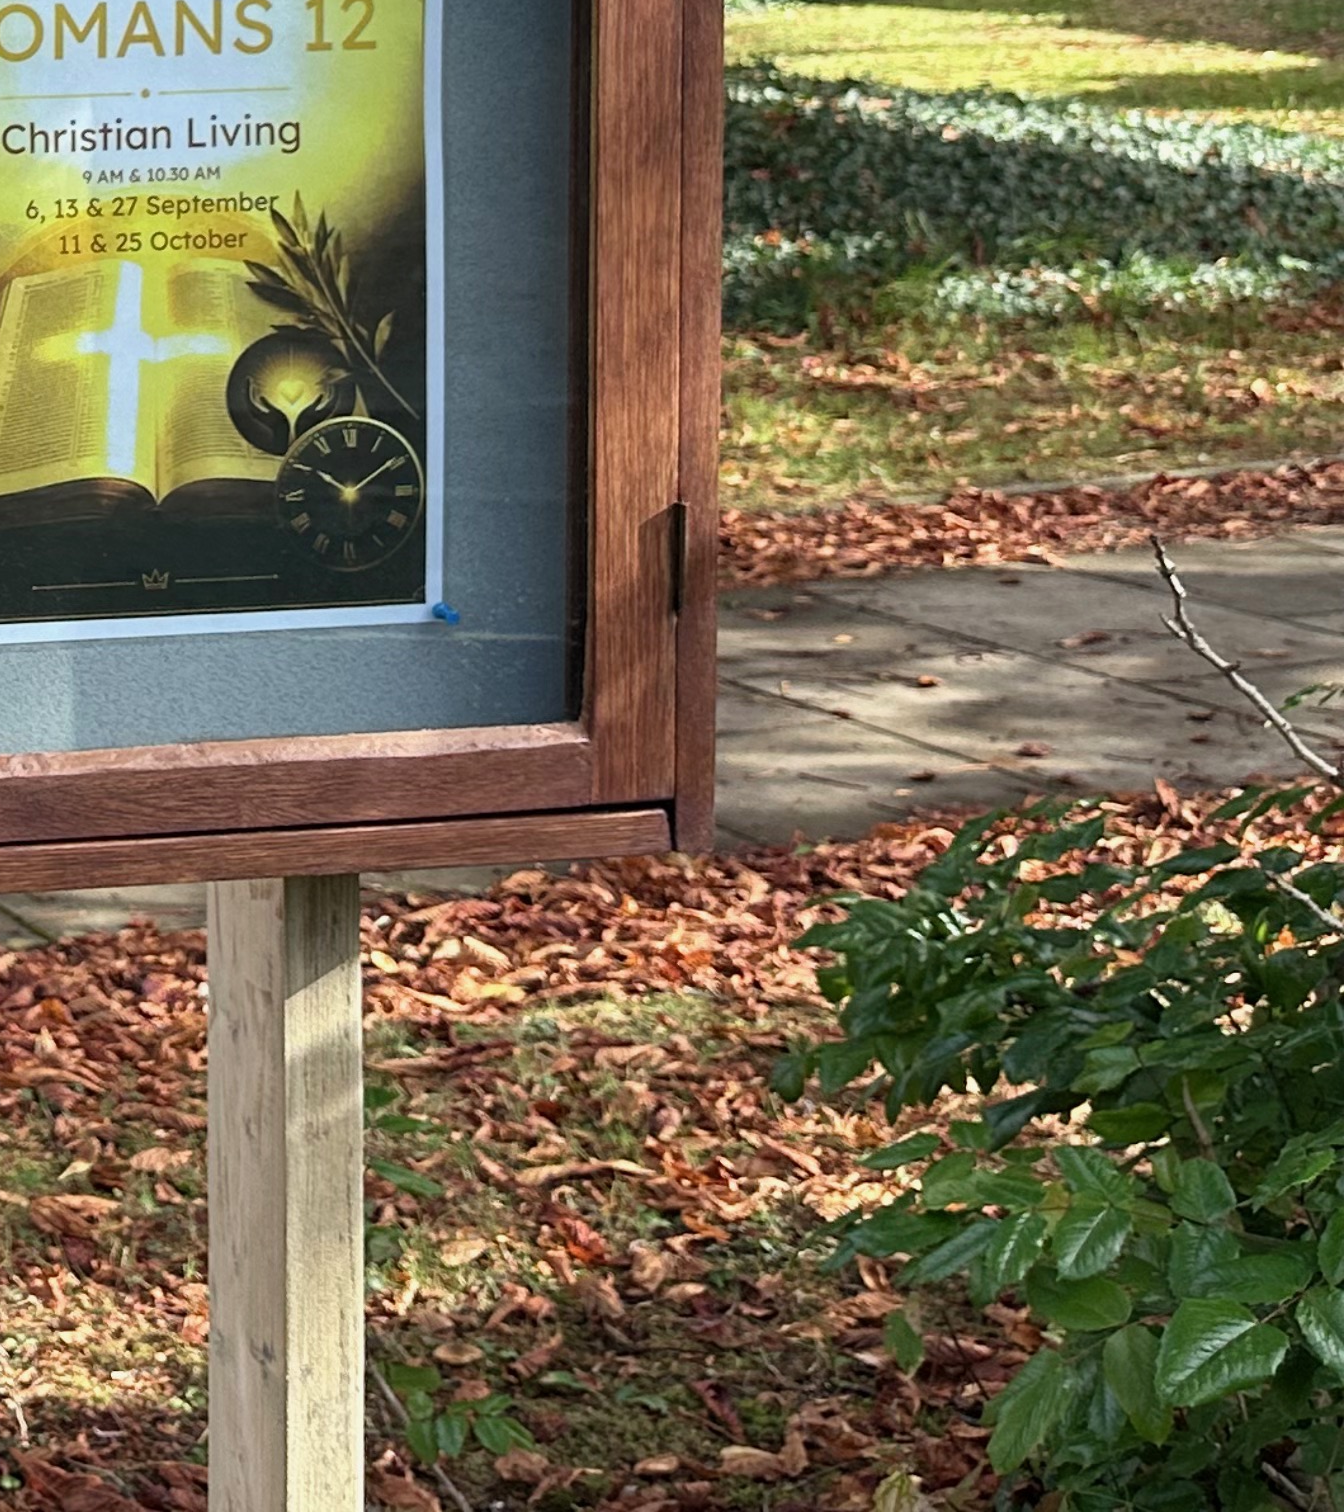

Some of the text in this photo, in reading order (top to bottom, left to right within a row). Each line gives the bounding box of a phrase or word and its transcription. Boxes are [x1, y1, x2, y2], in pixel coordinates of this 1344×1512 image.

[2, 113, 301, 155] Christian Living
[82, 166, 221, 184] 9 AM & 10.30 AM
[25, 191, 279, 224] 6, 13 & 27 September
[59, 229, 248, 255] 11 & 25 October
